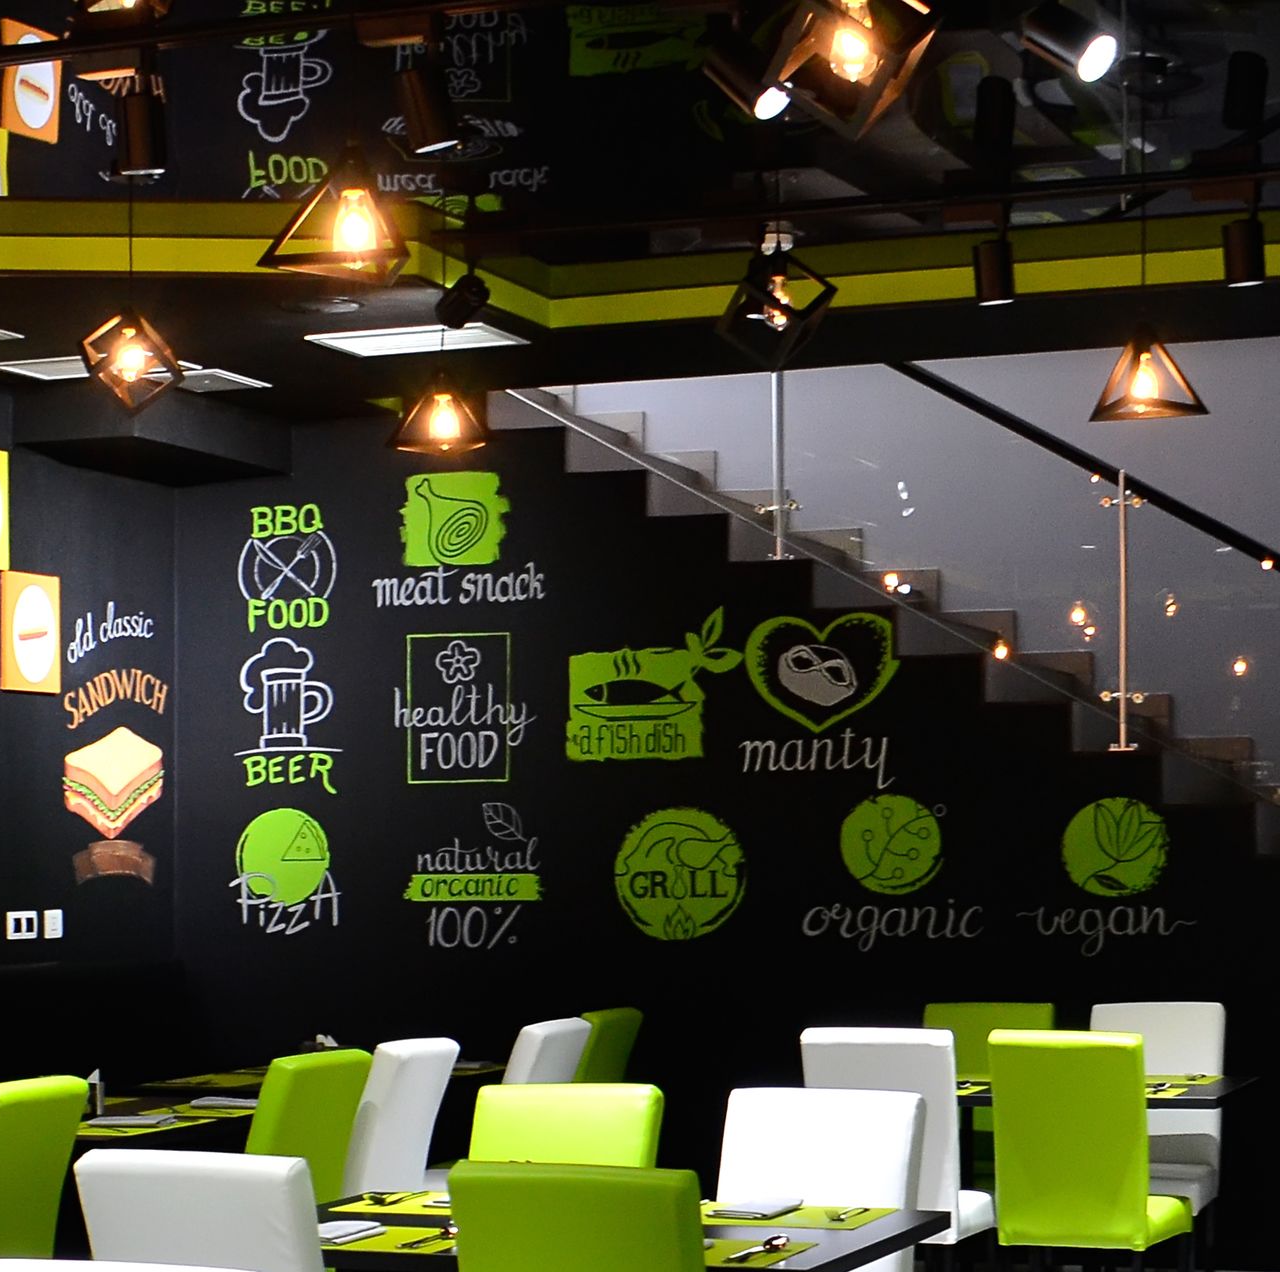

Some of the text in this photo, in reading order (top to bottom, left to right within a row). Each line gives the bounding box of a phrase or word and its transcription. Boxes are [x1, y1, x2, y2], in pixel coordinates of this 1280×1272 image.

[250, 503, 324, 538] BBQ
[372, 562, 546, 608] meat snack
[66, 601, 154, 663] old classic
[247, 597, 329, 633] FOOD
[64, 668, 168, 729] SANDWICH
[394, 684, 537, 746] healthy
[420, 731, 500, 771] FOOD
[580, 724, 593, 755] a
[738, 726, 895, 789] manty
[243, 751, 338, 794] BEER
[417, 837, 542, 874] natural
[426, 904, 522, 949] 100%
[801, 899, 984, 952] organic
